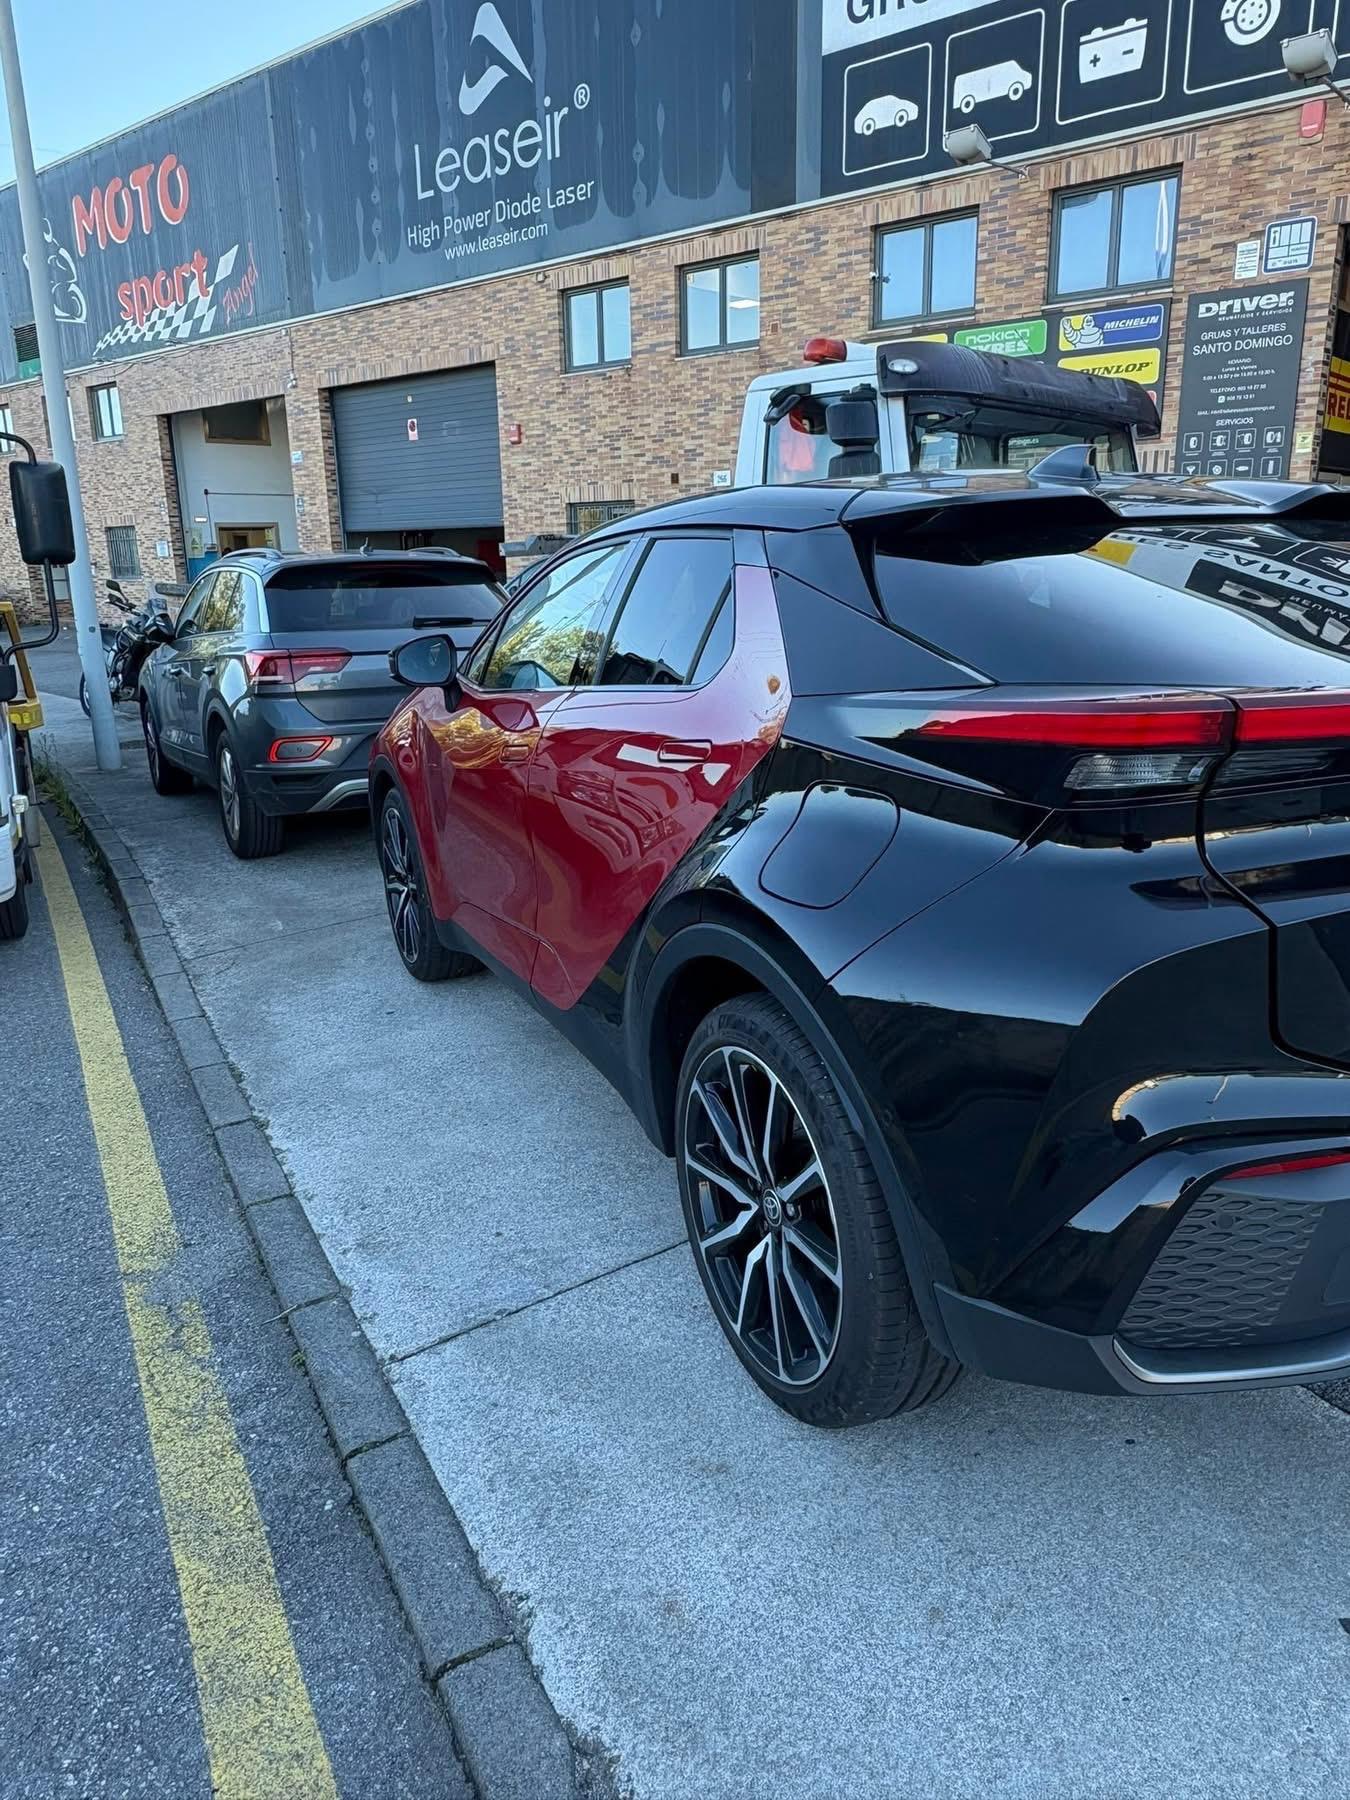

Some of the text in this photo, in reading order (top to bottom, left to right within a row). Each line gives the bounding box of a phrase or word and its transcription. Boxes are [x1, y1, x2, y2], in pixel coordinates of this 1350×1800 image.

[72, 153, 190, 258] MOTO
[407, 180, 594, 248] High Power Diode Laser
[444, 223, 548, 260] www.leaseir.com
[118, 249, 211, 329] sport
[1103, 315, 1159, 330] MICHELIN
[1200, 322, 1287, 341] GRUAS Y TALLERES
[1192, 334, 1293, 356] SANTO DOMINGO
[1327, 391, 1350, 420] RE
[1215, 416, 1254, 427] SERVICIOS
